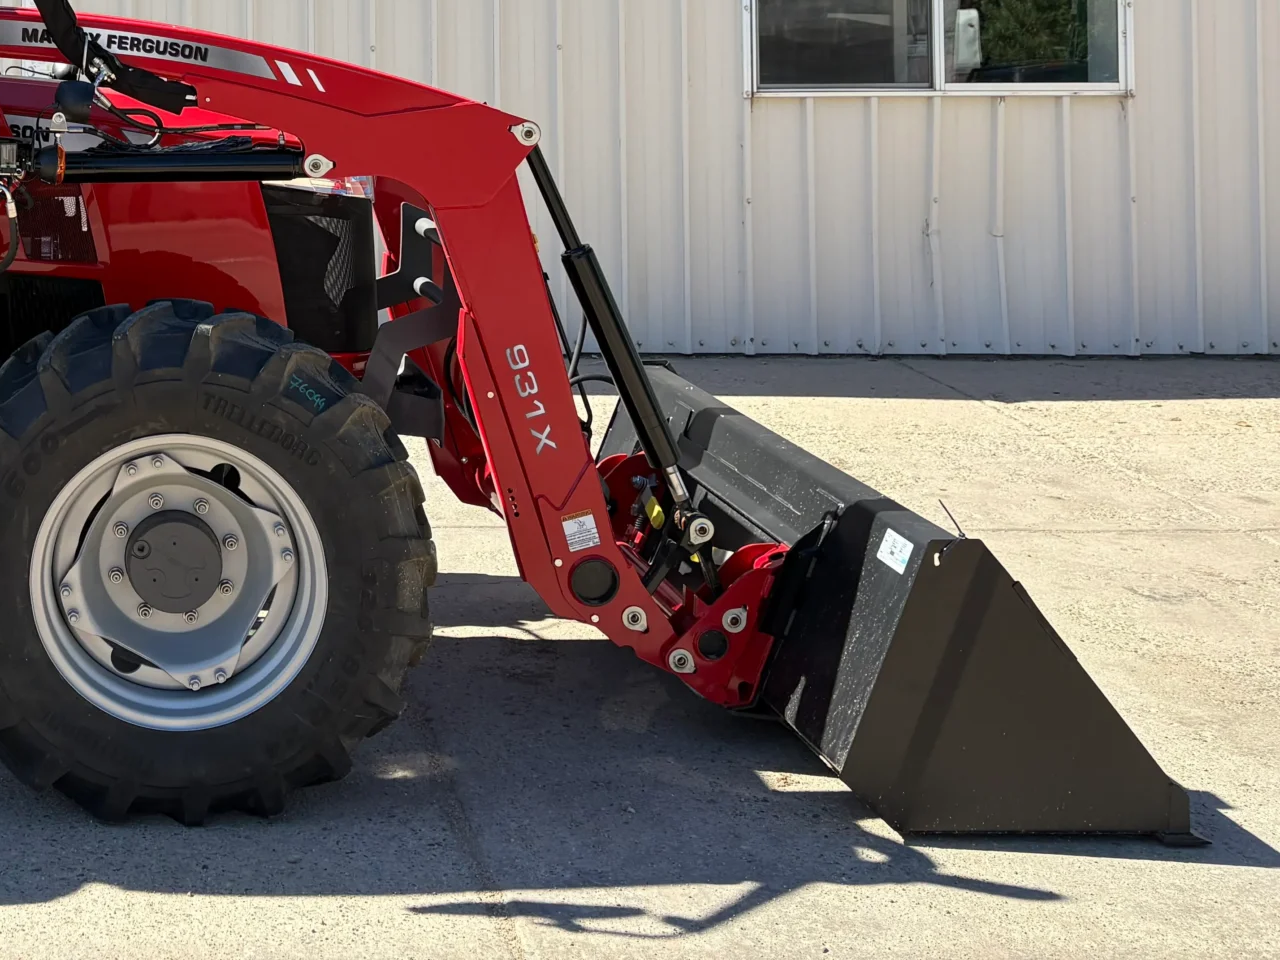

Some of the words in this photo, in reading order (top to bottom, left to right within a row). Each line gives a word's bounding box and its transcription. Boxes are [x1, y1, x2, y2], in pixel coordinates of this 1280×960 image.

[22, 27, 102, 44] MAY
[106, 34, 209, 62] FERGUSON
[202, 391, 320, 467] TRELLEBORG
[505, 343, 557, 455] 931X
